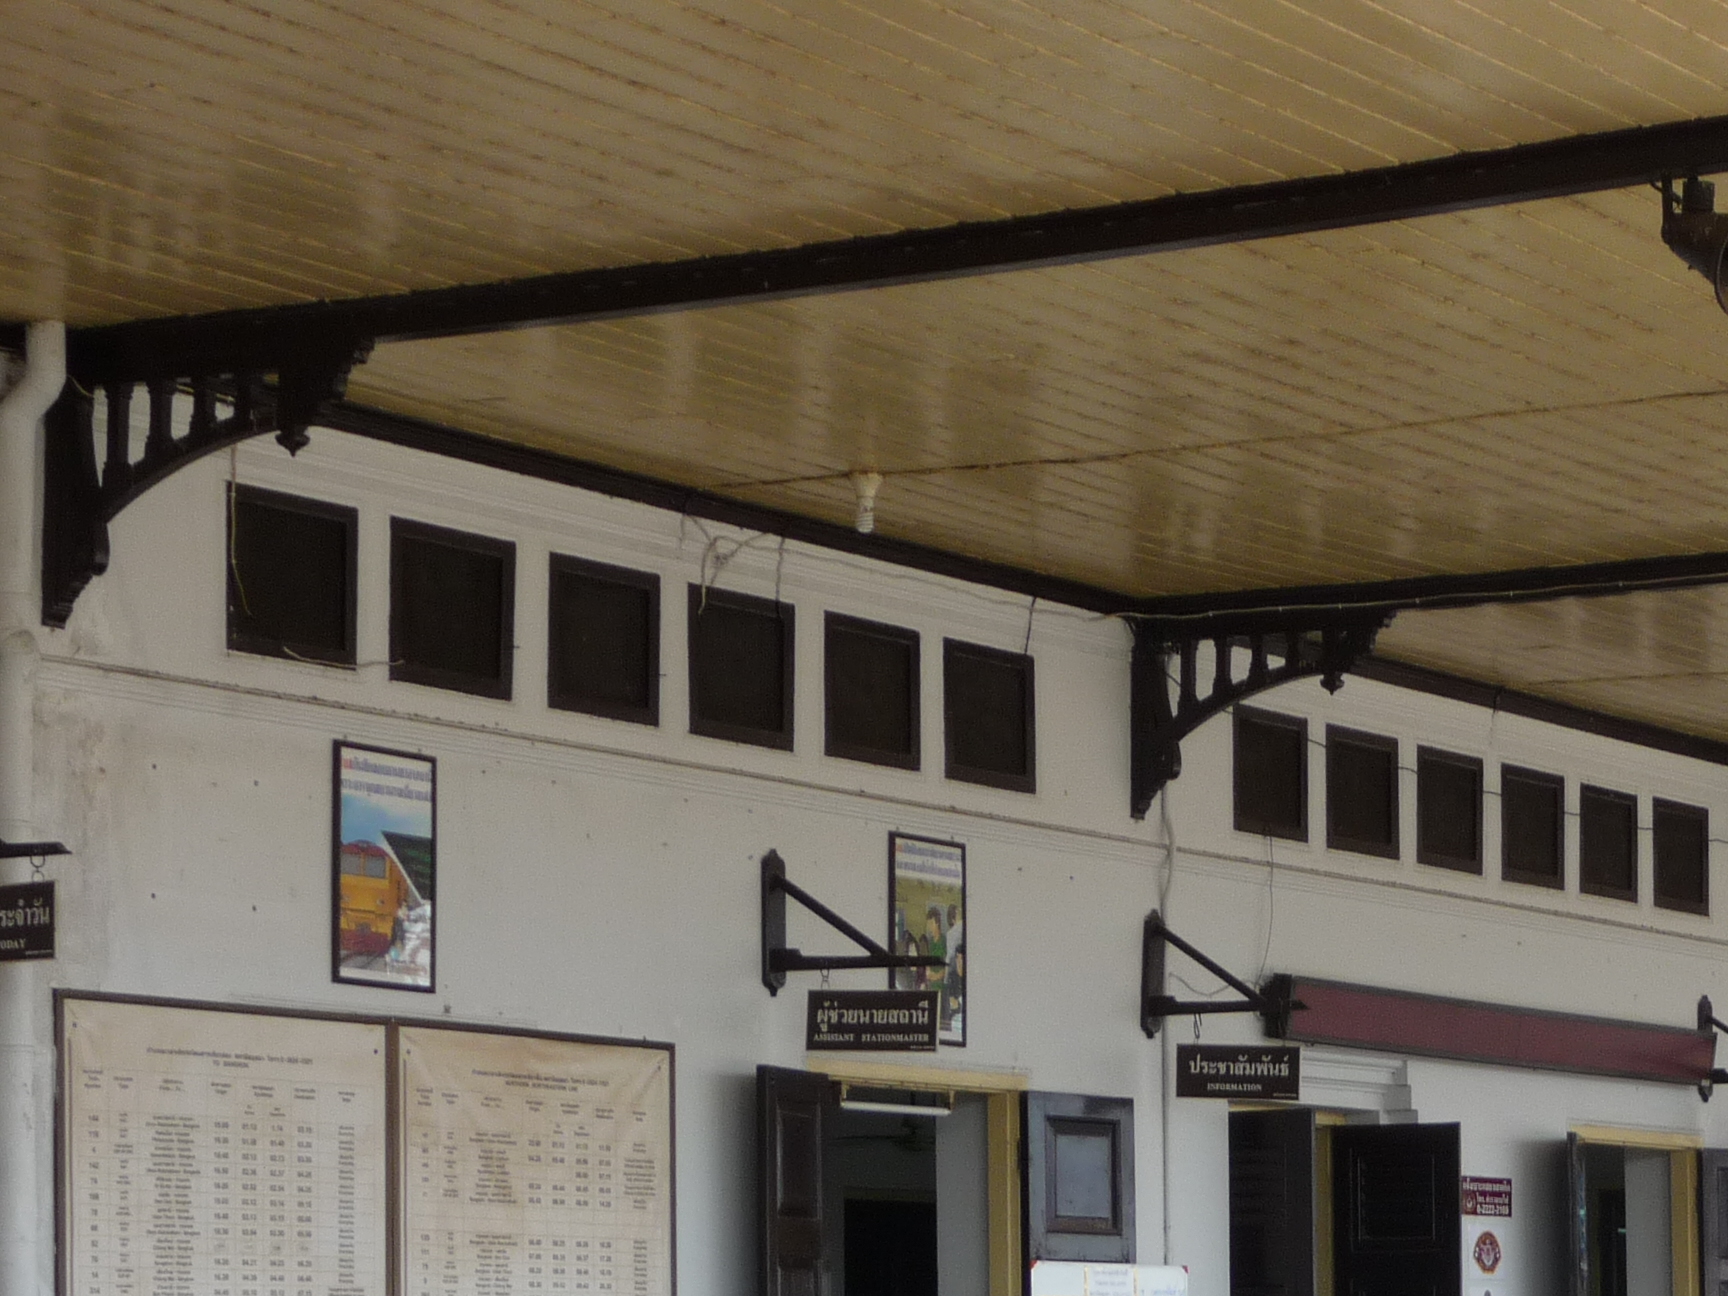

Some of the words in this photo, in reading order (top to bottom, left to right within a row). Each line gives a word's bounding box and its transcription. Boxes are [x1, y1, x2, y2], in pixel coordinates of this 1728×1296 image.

[817, 1000, 929, 1032] ผู้ช่วยนายสถานี
[814, 1033, 855, 1042] ASSISTANT
[861, 1033, 929, 1042] STATIONMASTER
[1189, 1054, 1289, 1077] ประชาสัมพันธ์
[1207, 1083, 1262, 1092] INFORMATION
